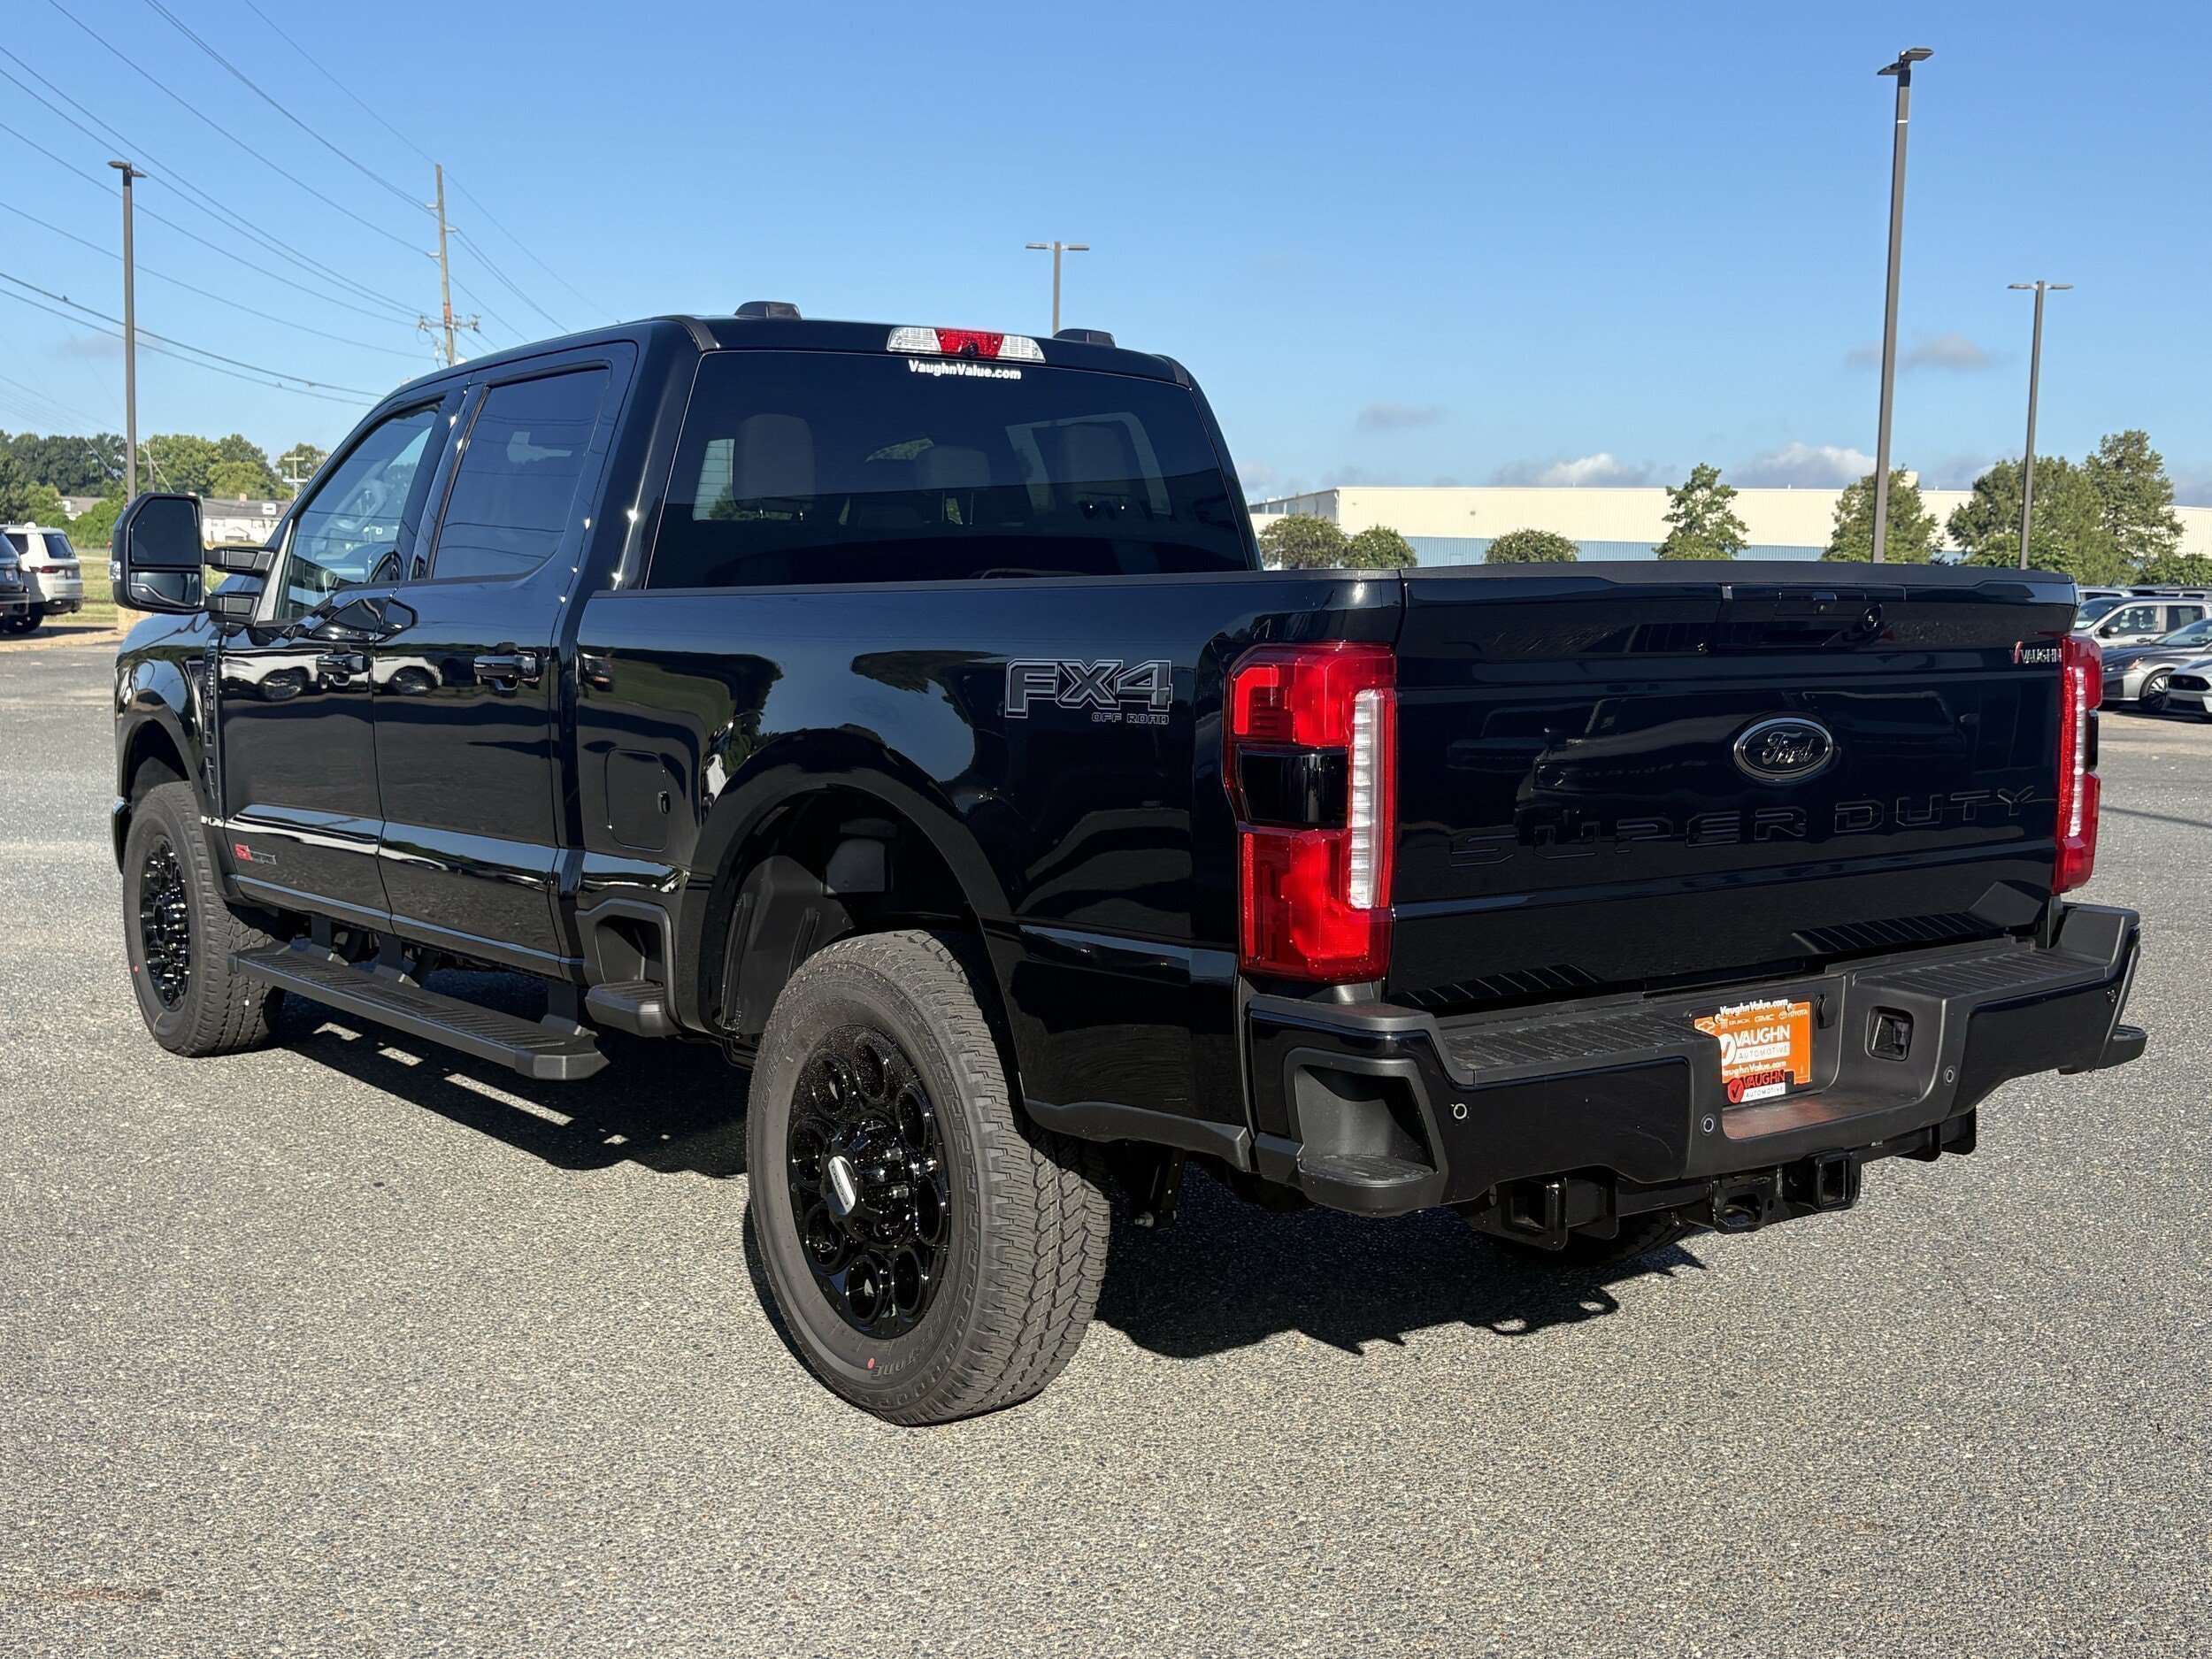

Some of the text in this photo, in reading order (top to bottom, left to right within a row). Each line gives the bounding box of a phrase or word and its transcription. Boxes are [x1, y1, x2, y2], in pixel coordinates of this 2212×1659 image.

[908, 360, 1022, 380] VaughnValue.com
[1005, 658, 1172, 718] FX4
[1091, 712, 1169, 725] OFF ROAD
[1763, 731, 1815, 764] Ford
[1450, 786, 2034, 867] SUPER DUTY
[1720, 999, 1788, 1016] VaughnValue.com
[1755, 1013, 1775, 1023] GMC
[1733, 1024, 1791, 1048] VAUGHN
[1739, 1045, 1787, 1060] AUTOMOTIVE
[1723, 1061, 1786, 1078] aughnValue.com
[1742, 1070, 1786, 1088] VAUGHN
[1746, 1087, 1784, 1098] AUTOMOTIVE
